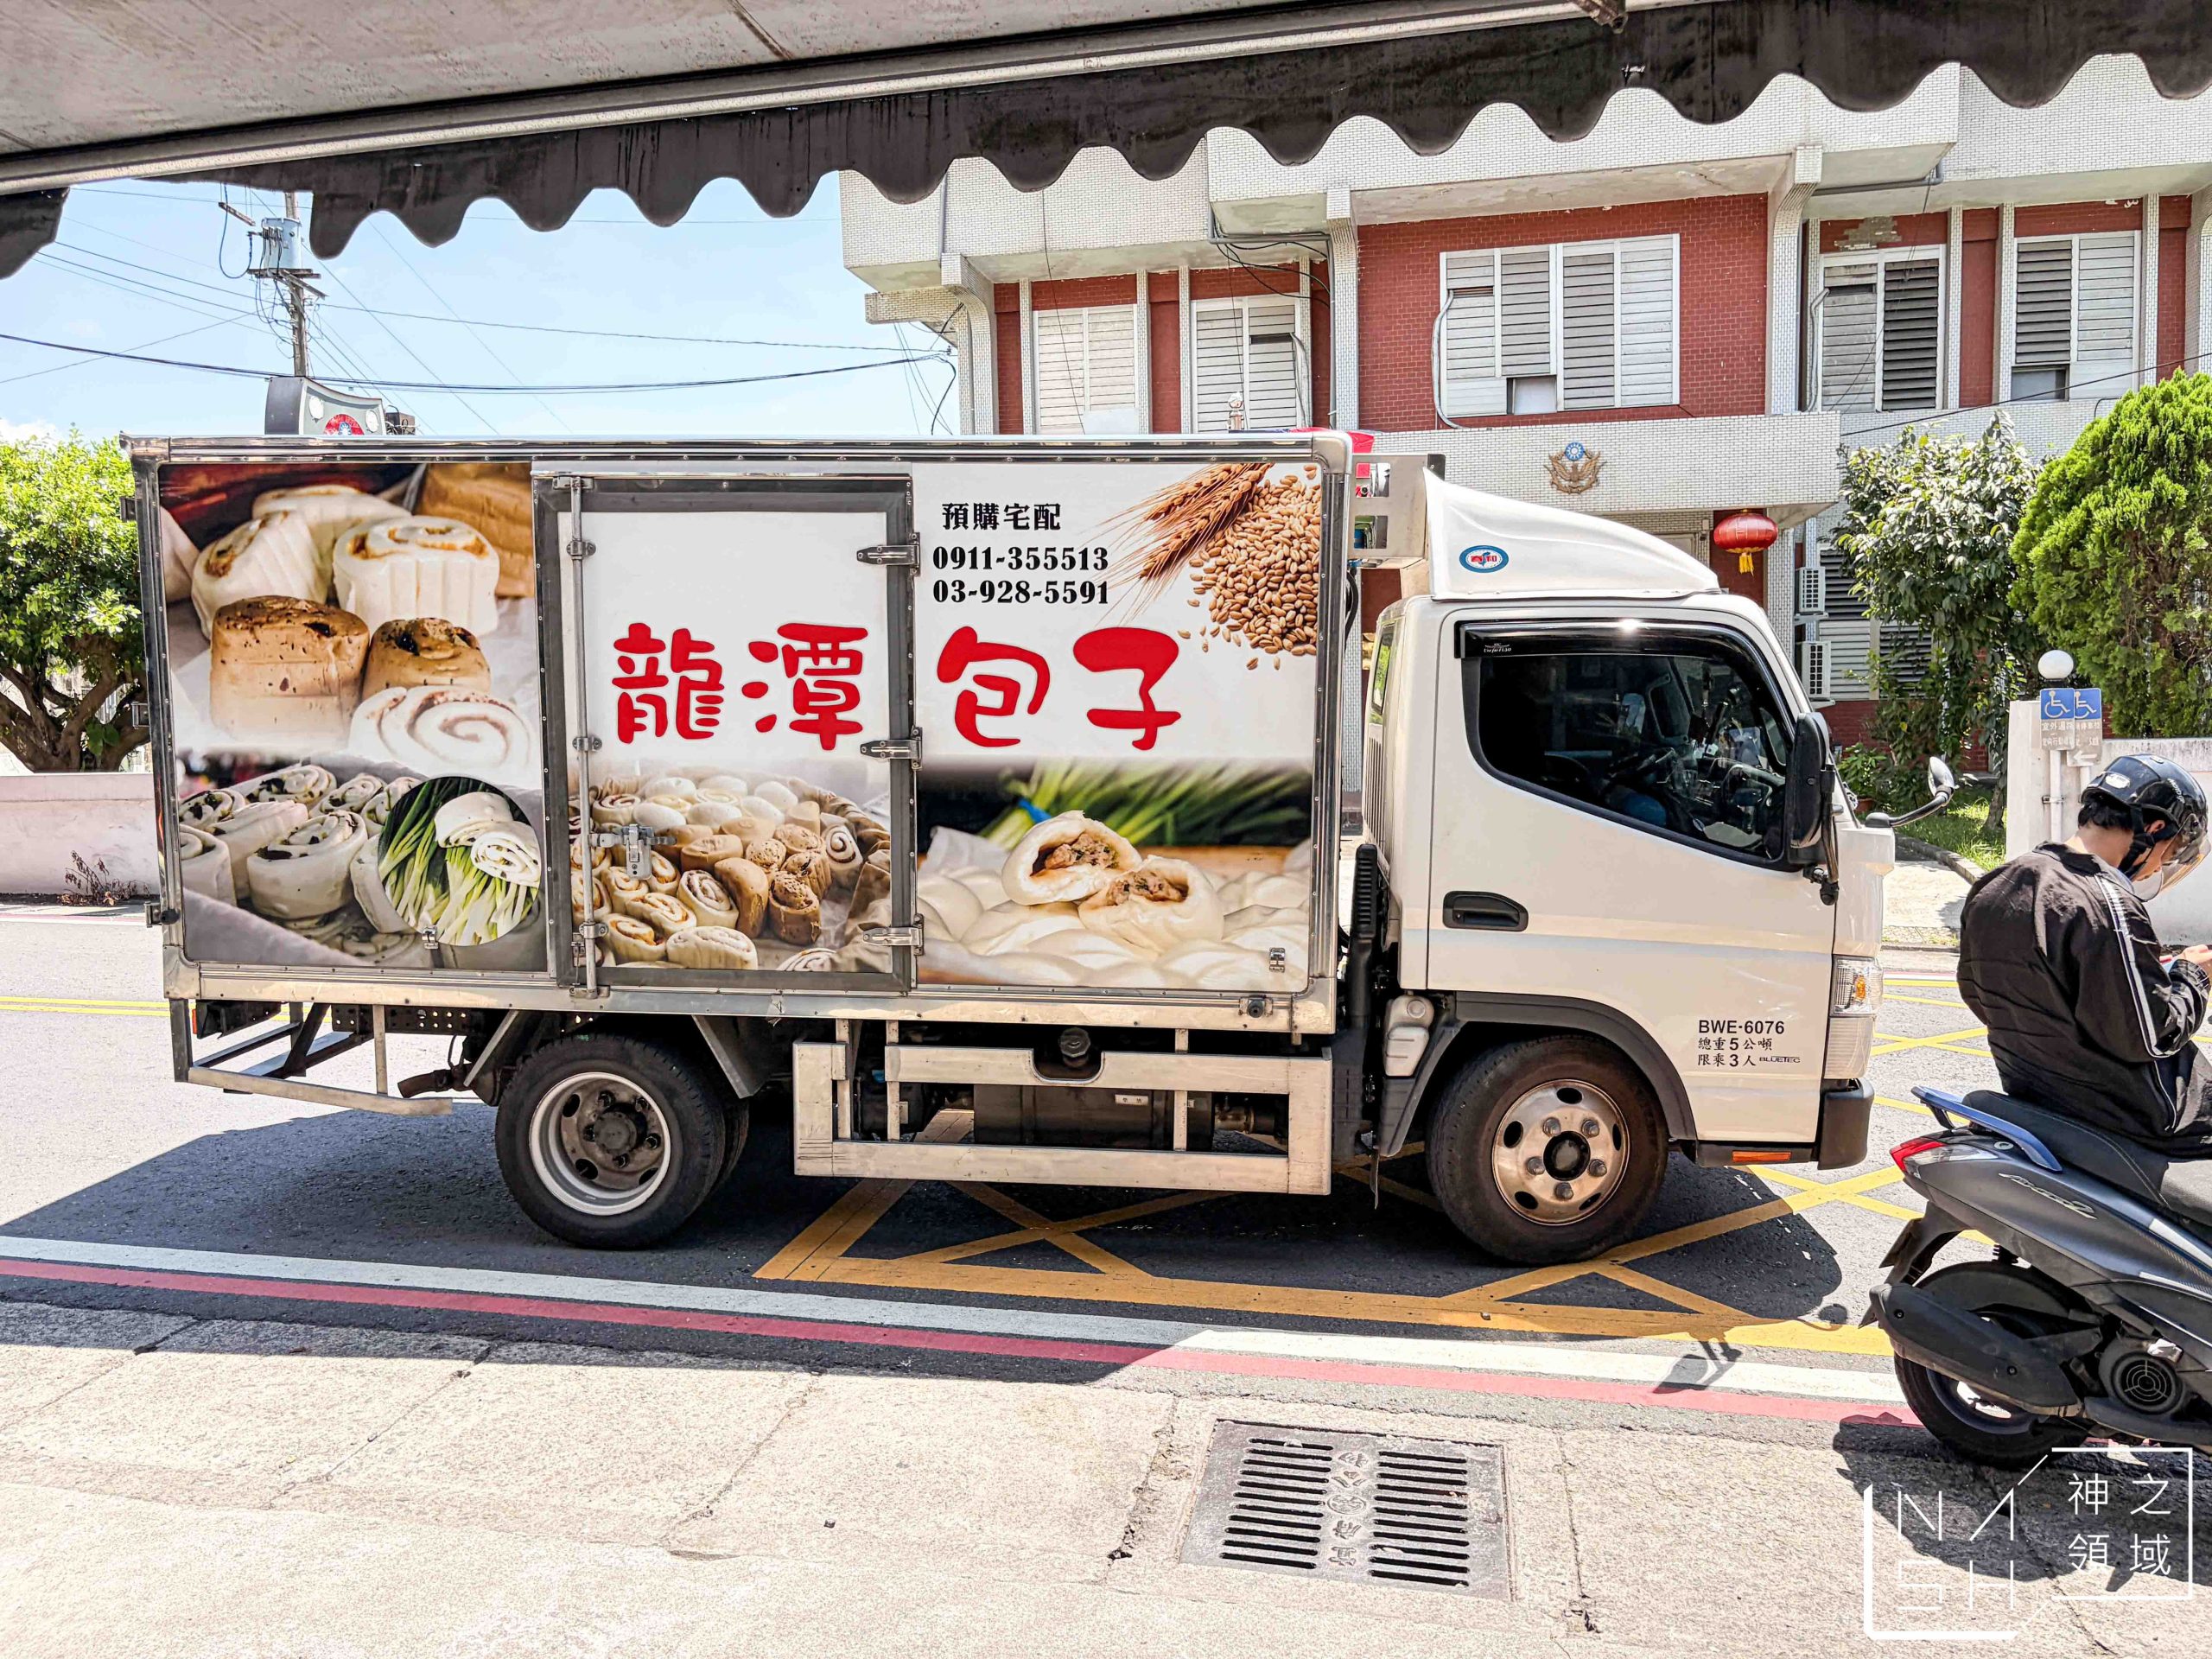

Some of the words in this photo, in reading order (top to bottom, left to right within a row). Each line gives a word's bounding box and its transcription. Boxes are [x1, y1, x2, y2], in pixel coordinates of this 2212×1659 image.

[941, 502, 1062, 532] 預購宅配
[932, 545, 1109, 571] 0911-355513
[932, 579, 1109, 605] 03-928-5591
[611, 622, 1181, 751] 龍潭包子
[1698, 1020, 1785, 1035] BWE-6076
